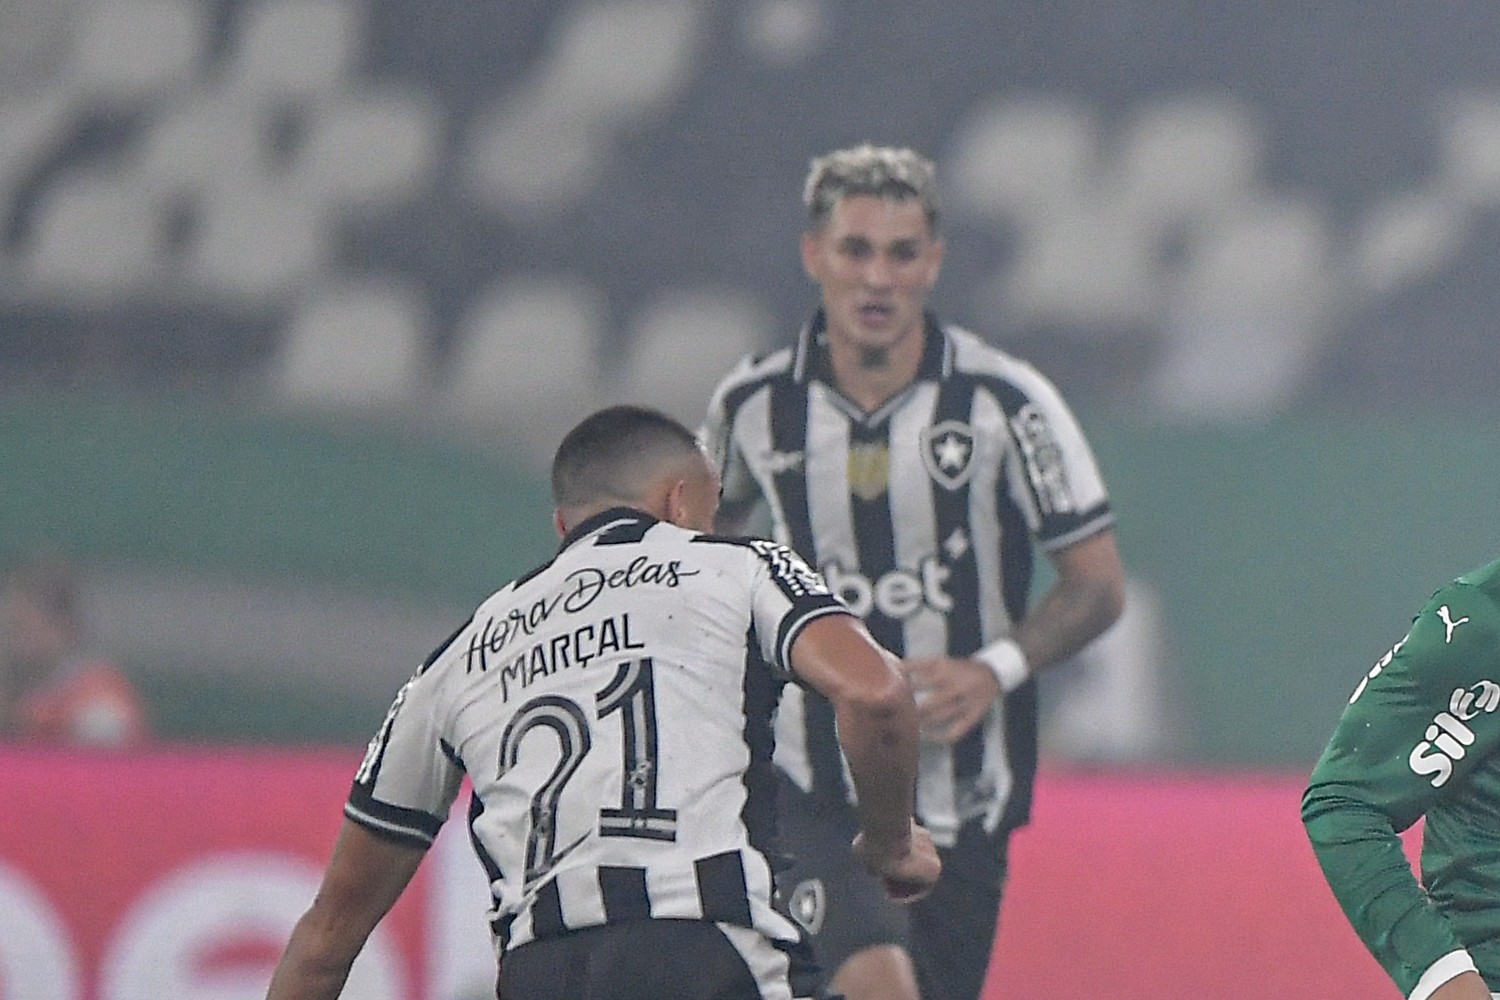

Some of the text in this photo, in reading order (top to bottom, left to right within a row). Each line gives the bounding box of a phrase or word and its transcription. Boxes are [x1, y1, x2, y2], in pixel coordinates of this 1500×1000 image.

[460, 592, 564, 675] Hora
[563, 555, 701, 614] Delas
[500, 612, 645, 703] MARÇAL
[496, 655, 678, 890] 21
